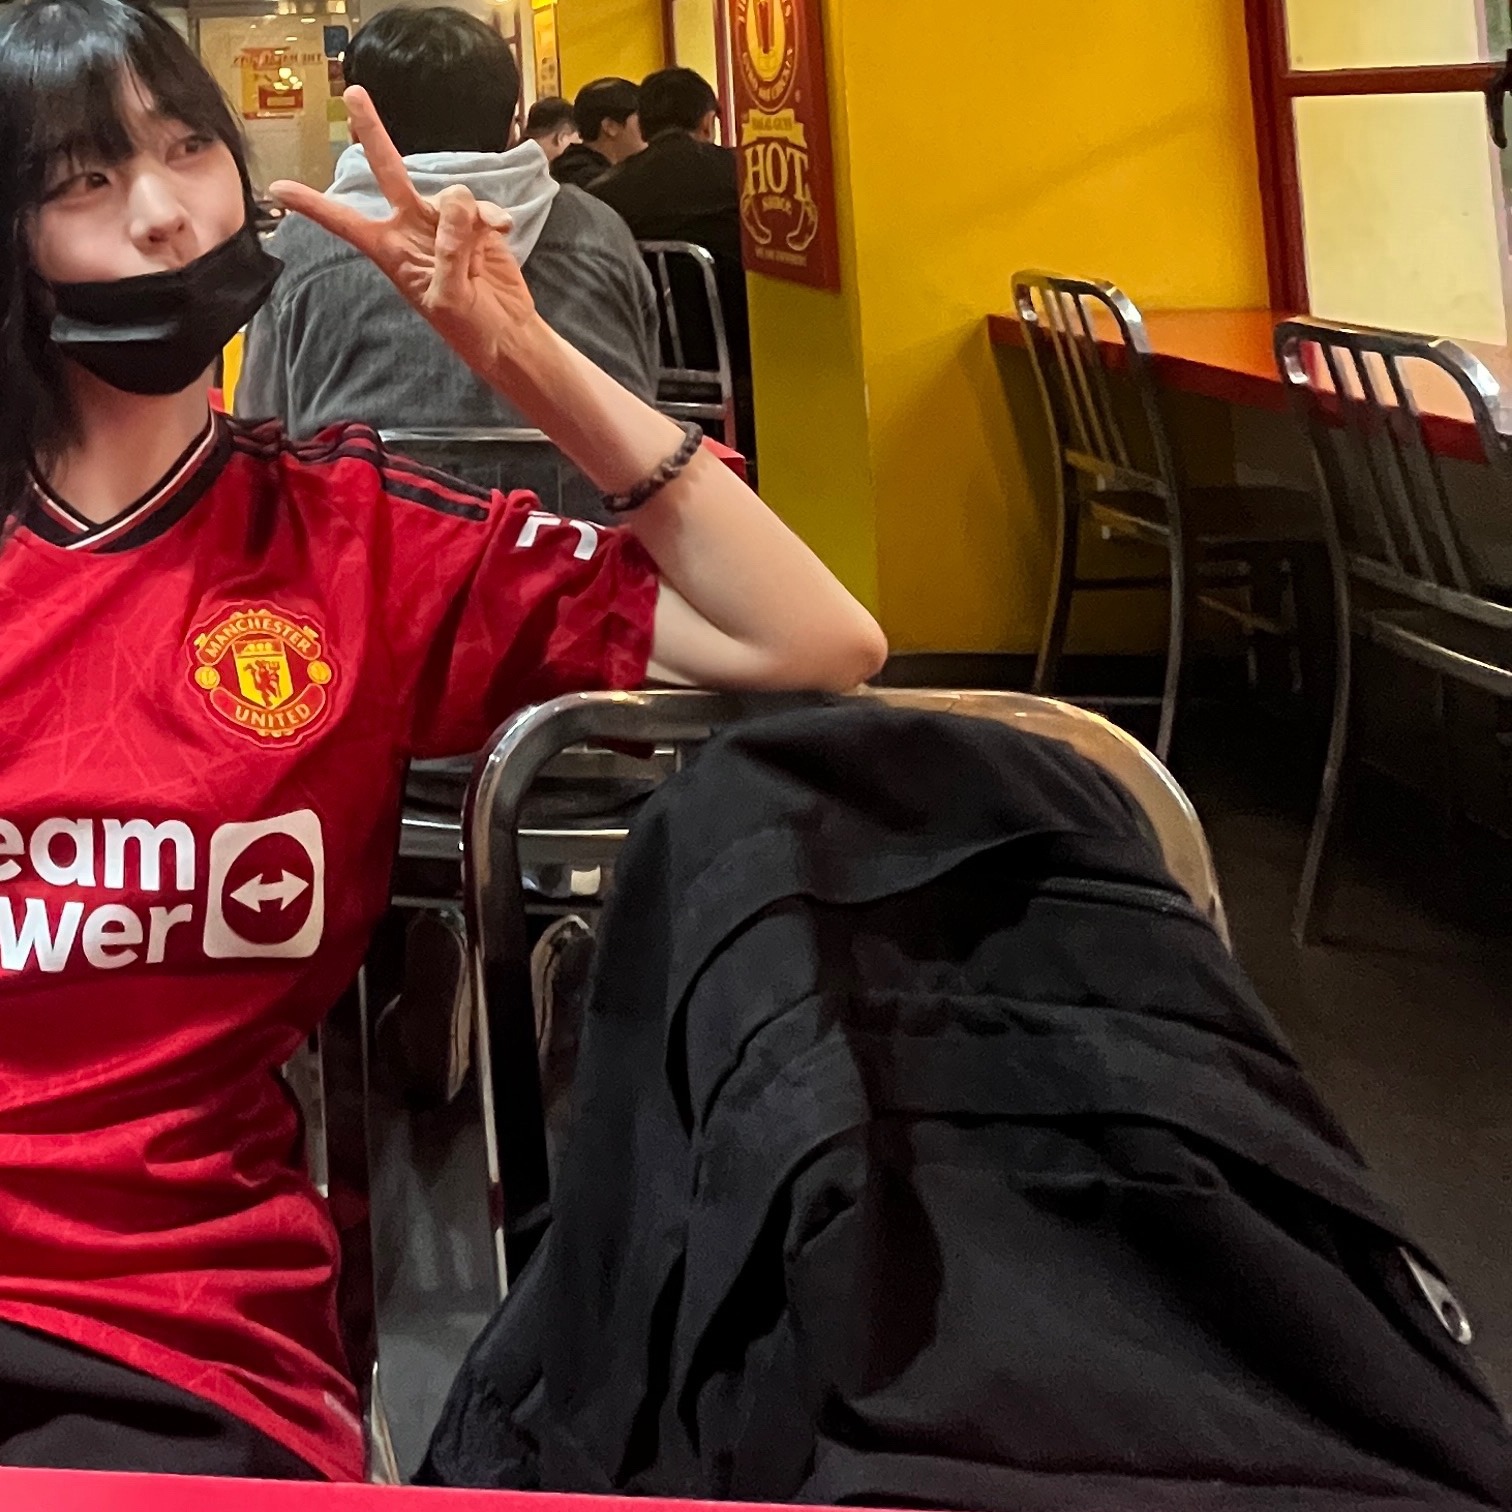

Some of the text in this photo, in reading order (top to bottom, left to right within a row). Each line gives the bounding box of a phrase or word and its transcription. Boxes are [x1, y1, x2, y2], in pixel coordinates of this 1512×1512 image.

[744, 141, 809, 201] HOT
[205, 617, 312, 659] MANCHESTER
[235, 703, 311, 728] UNITED
